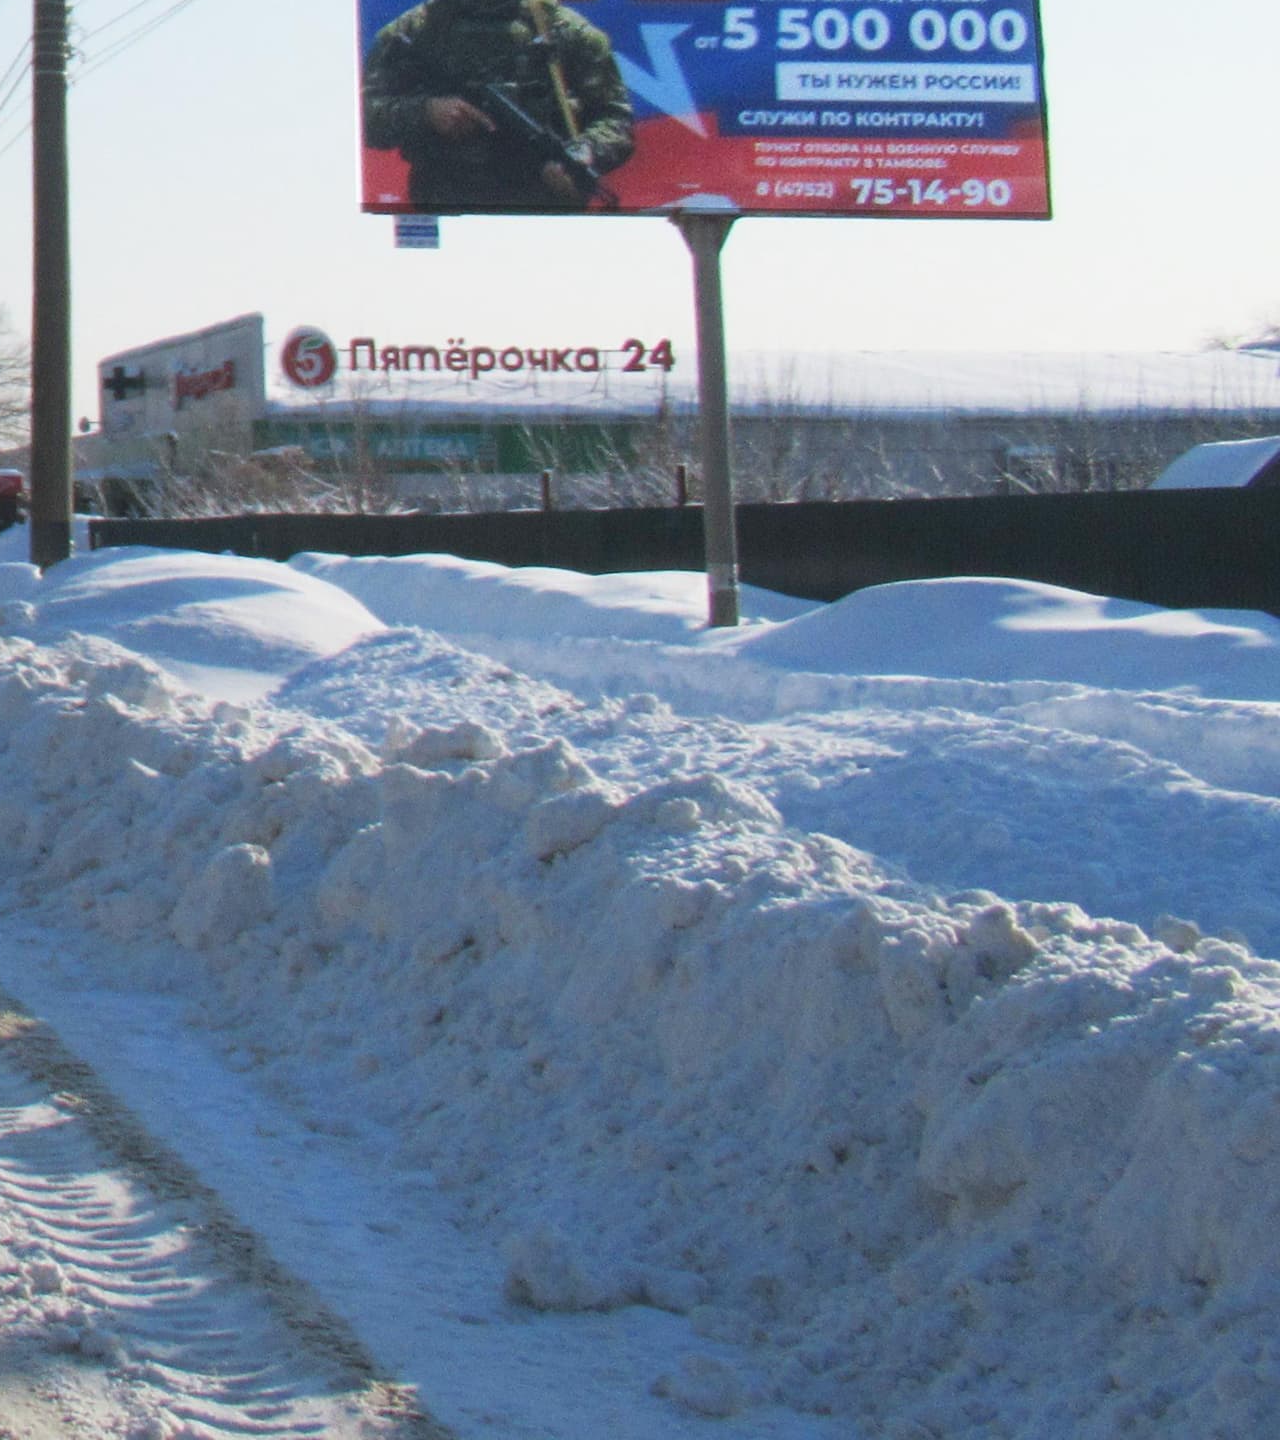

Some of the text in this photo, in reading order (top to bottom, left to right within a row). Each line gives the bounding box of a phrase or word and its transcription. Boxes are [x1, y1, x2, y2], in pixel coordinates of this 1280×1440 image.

[723, 7, 759, 50] 5
[776, 8, 890, 51] 500
[908, 8, 1028, 51] 000
[799, 73, 1022, 91] ТЫ НУЖЕН РОССИИ!
[738, 110, 984, 128] СЛУЖИ ПО КОНТРАКТУ!
[754, 143, 1021, 156] ПУНКТ ОТБОРА НА ВОЕННУЮ СЛУЖБУ
[754, 157, 777, 167] ПО
[779, 157, 860, 168] КОНТРАКТУ
[755, 177, 1013, 206] 8 (4752) 75-14-90
[349, 338, 599, 380] Пятёрочка
[621, 338, 676, 373] 24
